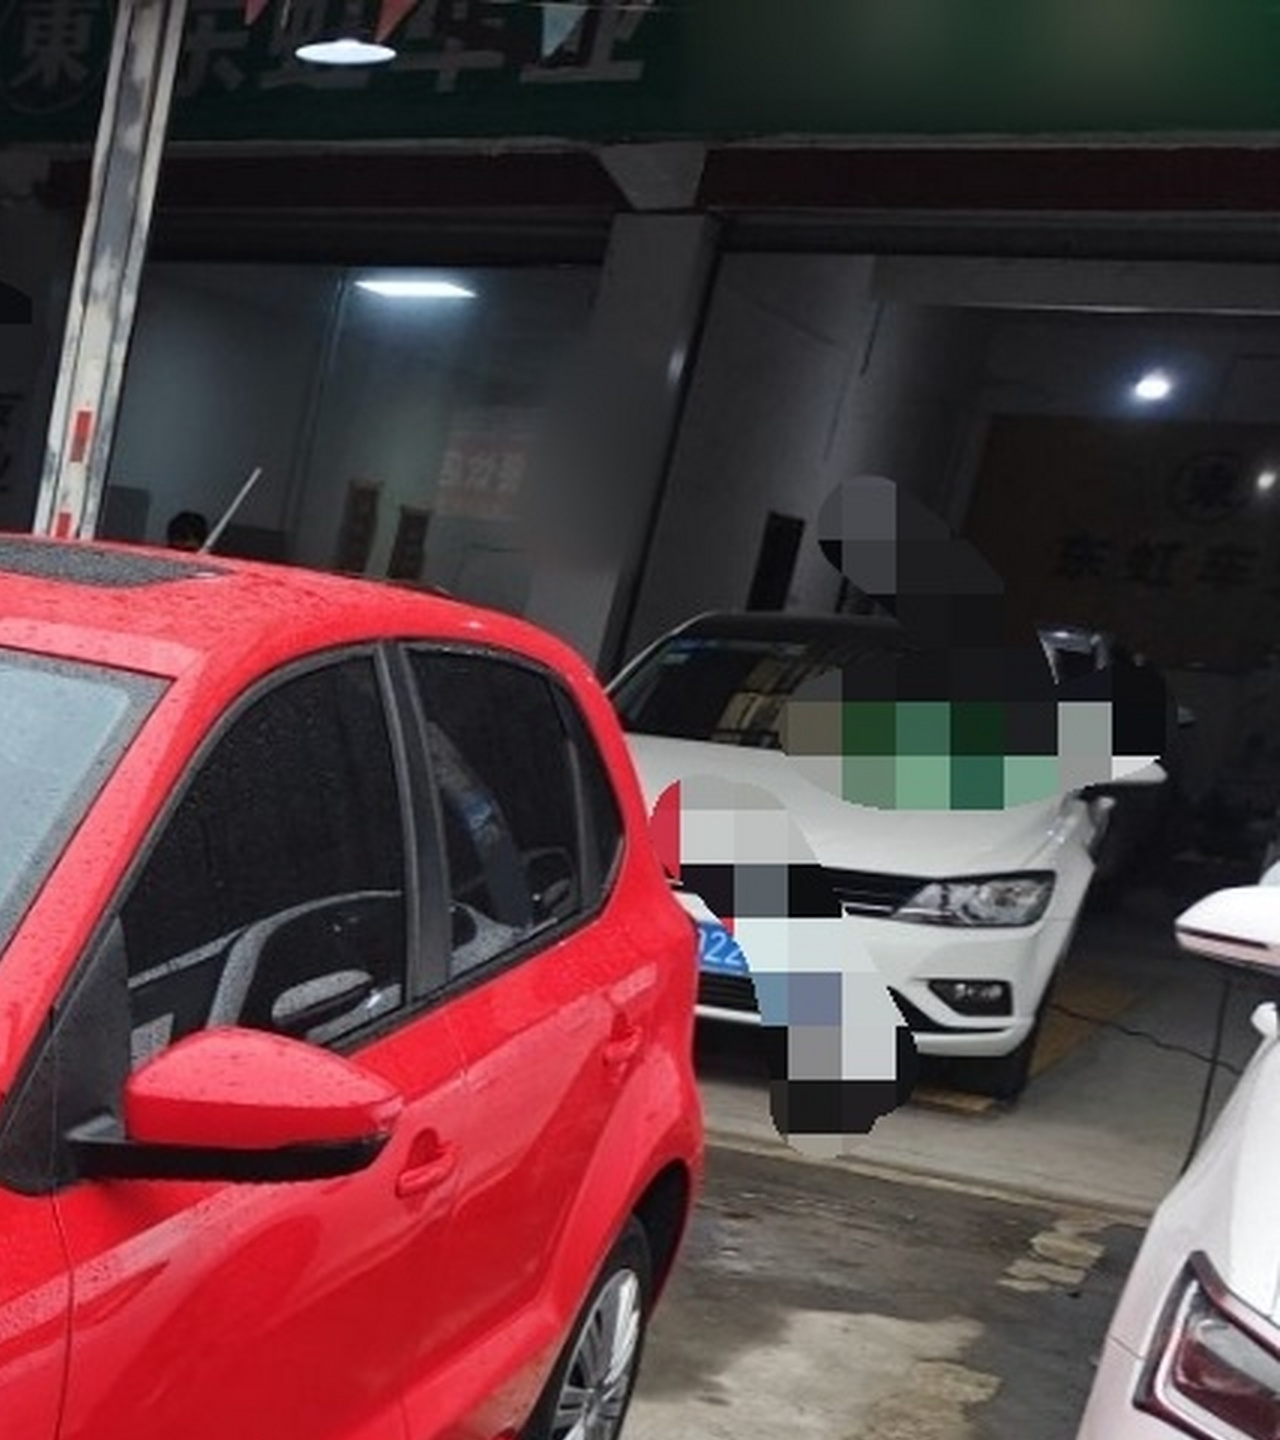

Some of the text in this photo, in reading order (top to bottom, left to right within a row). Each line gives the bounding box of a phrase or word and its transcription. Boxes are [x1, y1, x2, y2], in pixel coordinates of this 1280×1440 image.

[9, 0, 104, 90] 東
[1050, 531, 1280, 600] 东虹车
